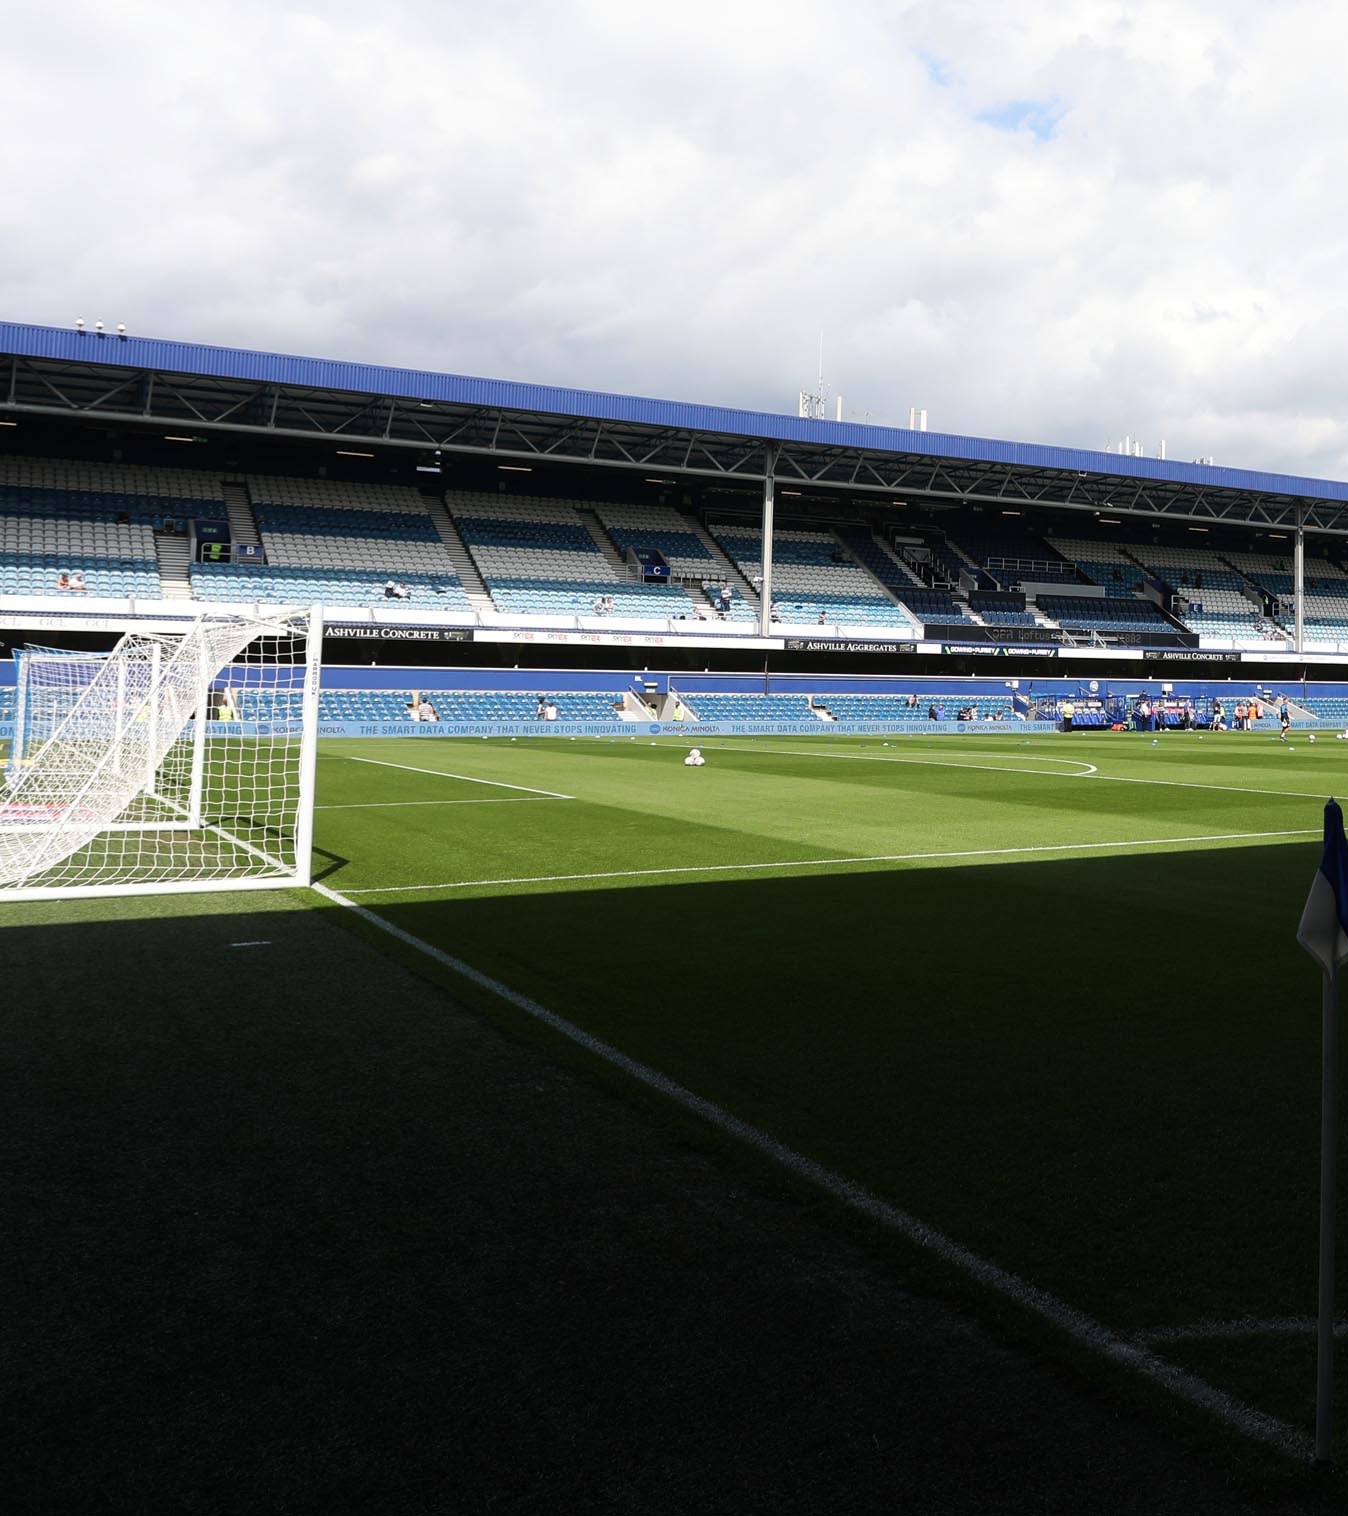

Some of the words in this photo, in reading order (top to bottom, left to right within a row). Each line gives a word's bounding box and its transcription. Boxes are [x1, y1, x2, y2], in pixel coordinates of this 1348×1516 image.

[246, 546, 255, 555] B
[653, 566, 661, 575] C
[325, 627, 379, 638] ASHVILLE
[380, 628, 440, 640] CONCRETE
[1018, 630, 1051, 640] Loftus
[806, 641, 846, 651] ASHVILLE
[846, 642, 897, 653] AGGREGATES
[1162, 652, 1192, 660] ASHVILLE
[1192, 652, 1224, 661] CONCRETE
[360, 725, 379, 735] THE
[381, 725, 415, 735] SMART
[419, 725, 445, 735] DATA
[447, 725, 494, 735] COMPANY
[496, 725, 519, 735] THAT
[522, 725, 551, 734] NEVER
[553, 724, 582, 734] STOPS
[585, 724, 637, 734] INNOVATING
[662, 725, 690, 733] KONICA
[691, 725, 720, 733] MINOLTA
[731, 724, 746, 733] THE
[749, 724, 774, 733] SMART
[777, 724, 797, 733] DATA
[799, 724, 836, 733] COMPANY
[837, 724, 855, 733] THAT
[857, 724, 879, 732] NEVER
[882, 724, 905, 732] STOPS
[906, 723, 947, 732] INNOVATING
[1033, 723, 1056, 731] SMART
